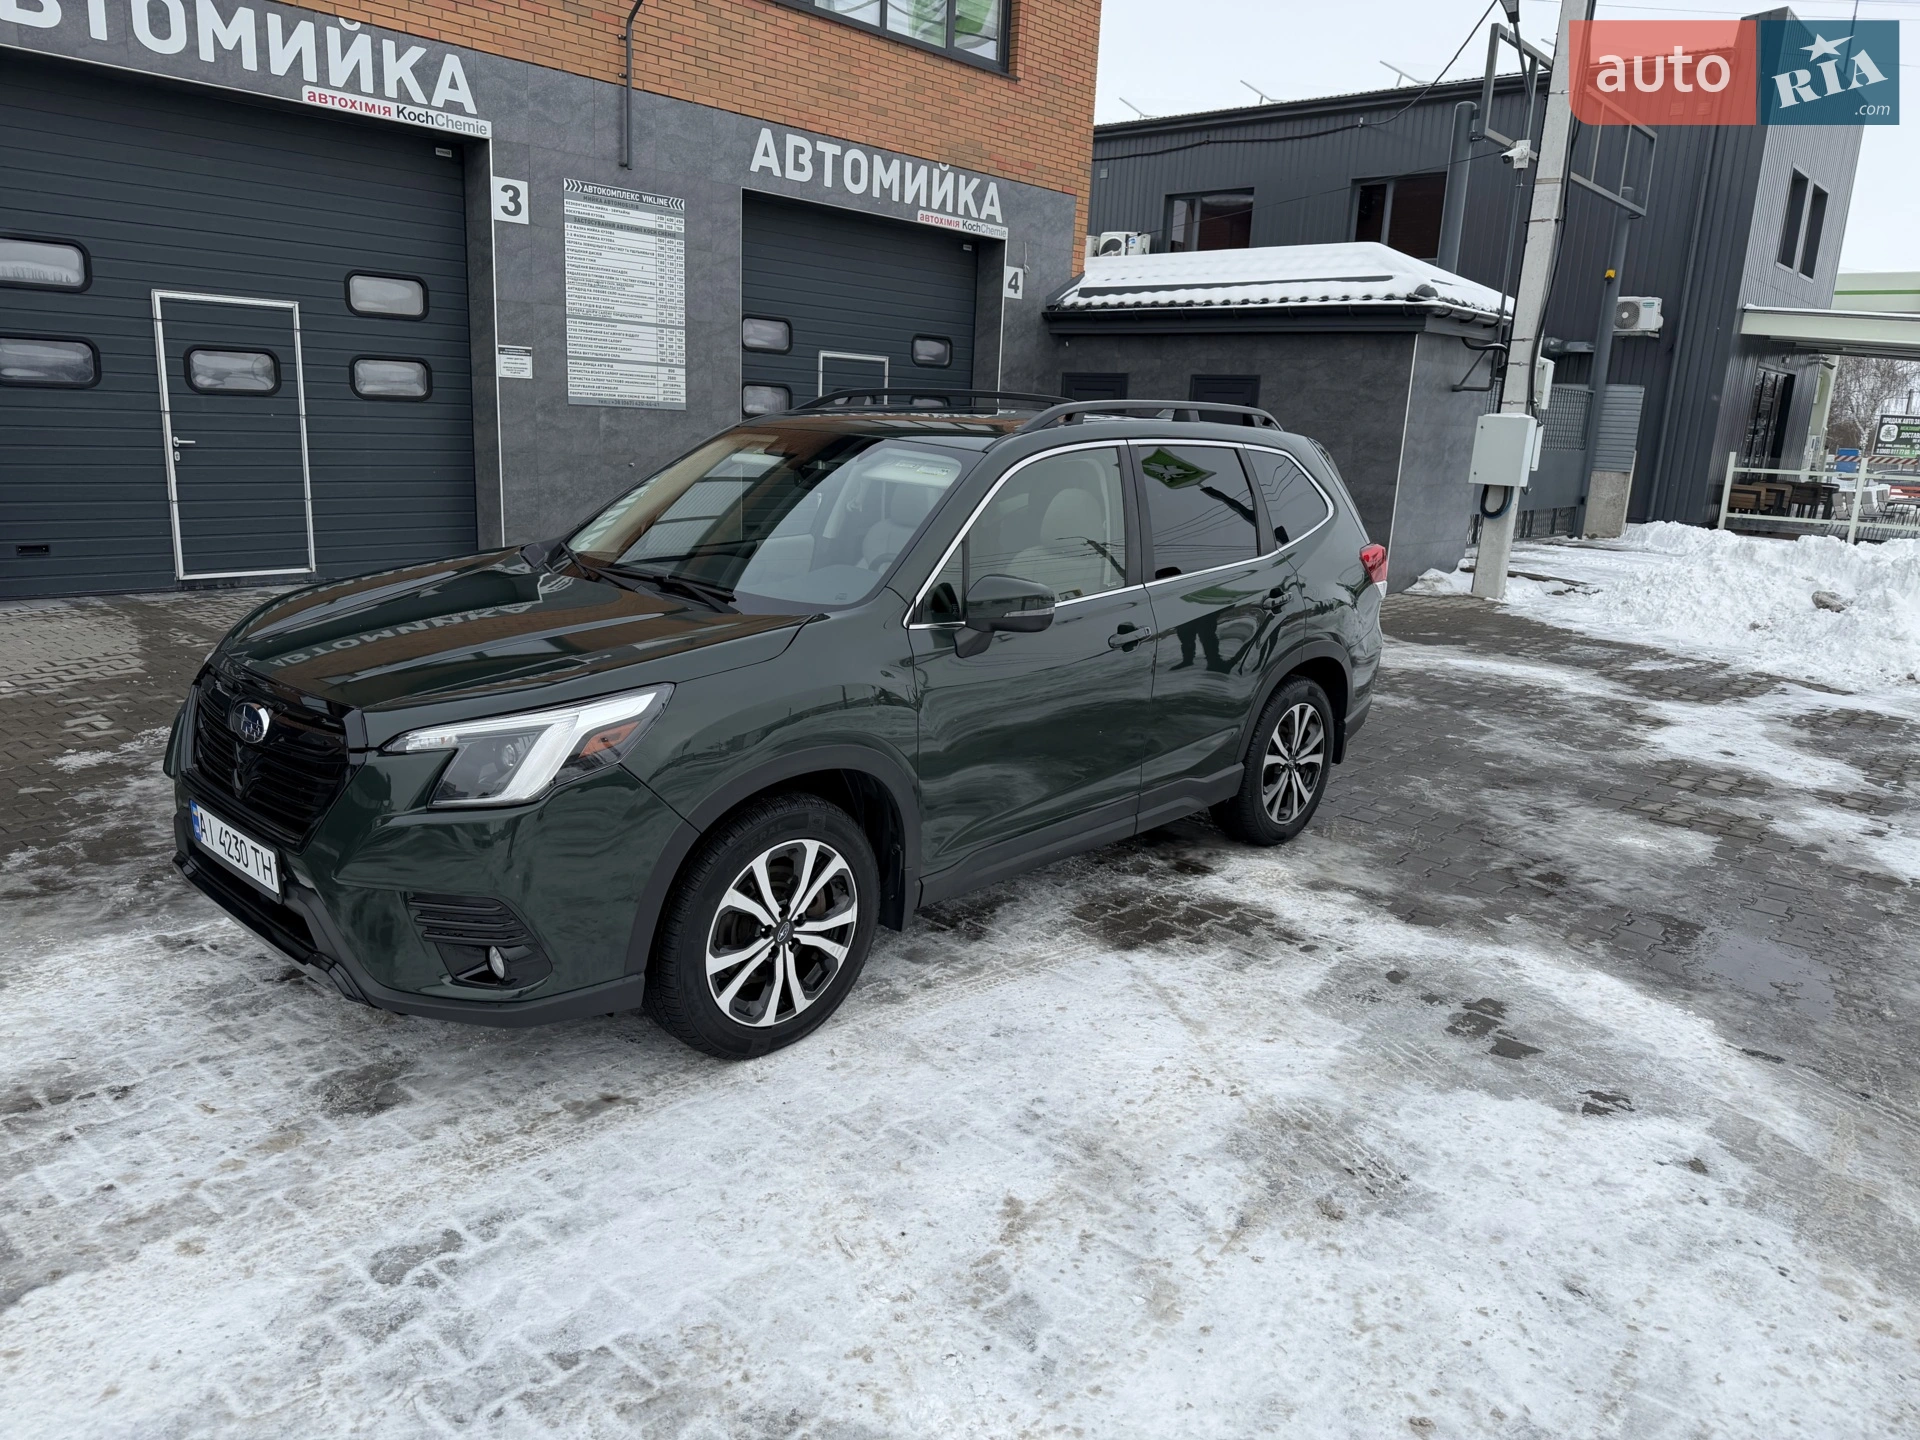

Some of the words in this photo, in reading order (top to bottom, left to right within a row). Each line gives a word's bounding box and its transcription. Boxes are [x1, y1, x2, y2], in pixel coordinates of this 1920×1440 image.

[307, 90, 392, 117] автохімія
[750, 127, 1003, 223] АВТОМИЙКА
[500, 184, 522, 217] 3
[583, 184, 640, 202] АВТОКОМПЛЕКС
[642, 194, 668, 206] VIKLINE
[1007, 270, 1020, 294] 4
[200, 812, 215, 846] AI
[219, 826, 249, 868] 4230
[250, 845, 274, 886] TH
